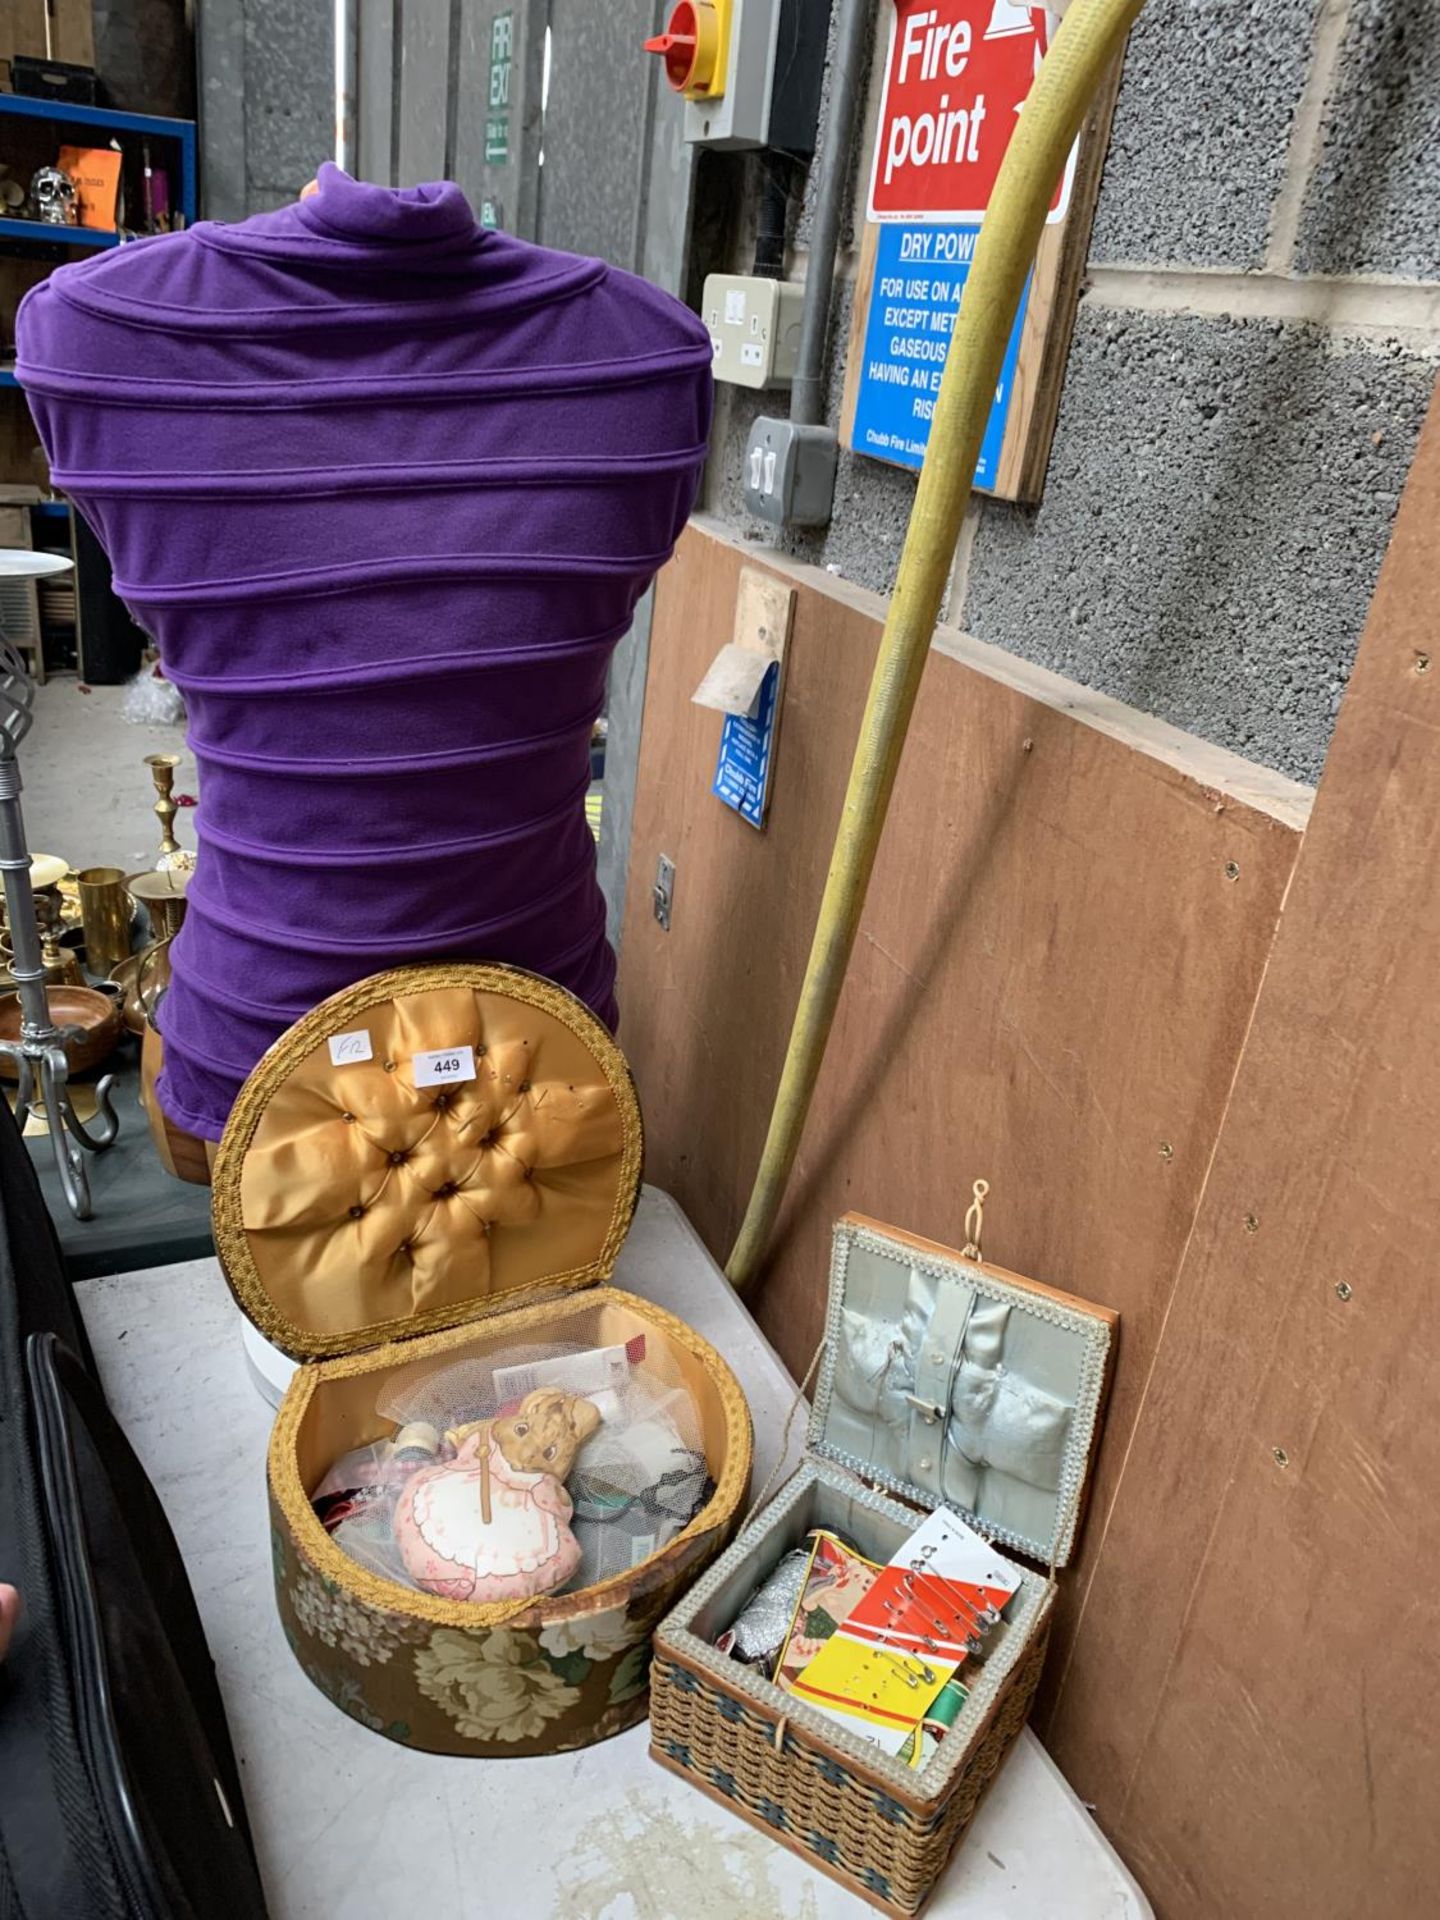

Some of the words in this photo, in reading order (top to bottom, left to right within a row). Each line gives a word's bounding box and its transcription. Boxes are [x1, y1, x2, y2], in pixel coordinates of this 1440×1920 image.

[898, 9, 972, 84] Fire
[884, 94, 986, 185] point
[900, 233, 932, 259] DRY
[934, 233, 979, 261] POW
[880, 278, 902, 298] FOR
[905, 280, 929, 300] USE
[931, 282, 949, 302] ON
[884, 307, 929, 330] EXCEPT
[930, 311, 958, 333] MET
[890, 336, 946, 362] GASEOUS
[868, 361, 909, 385] HAVING
[910, 368, 929, 389] AN
[912, 398, 936, 420] RIS
[866, 429, 889, 448] Chubb
[890, 435, 905, 451] Fire
[434, 1058, 460, 1073] 449
